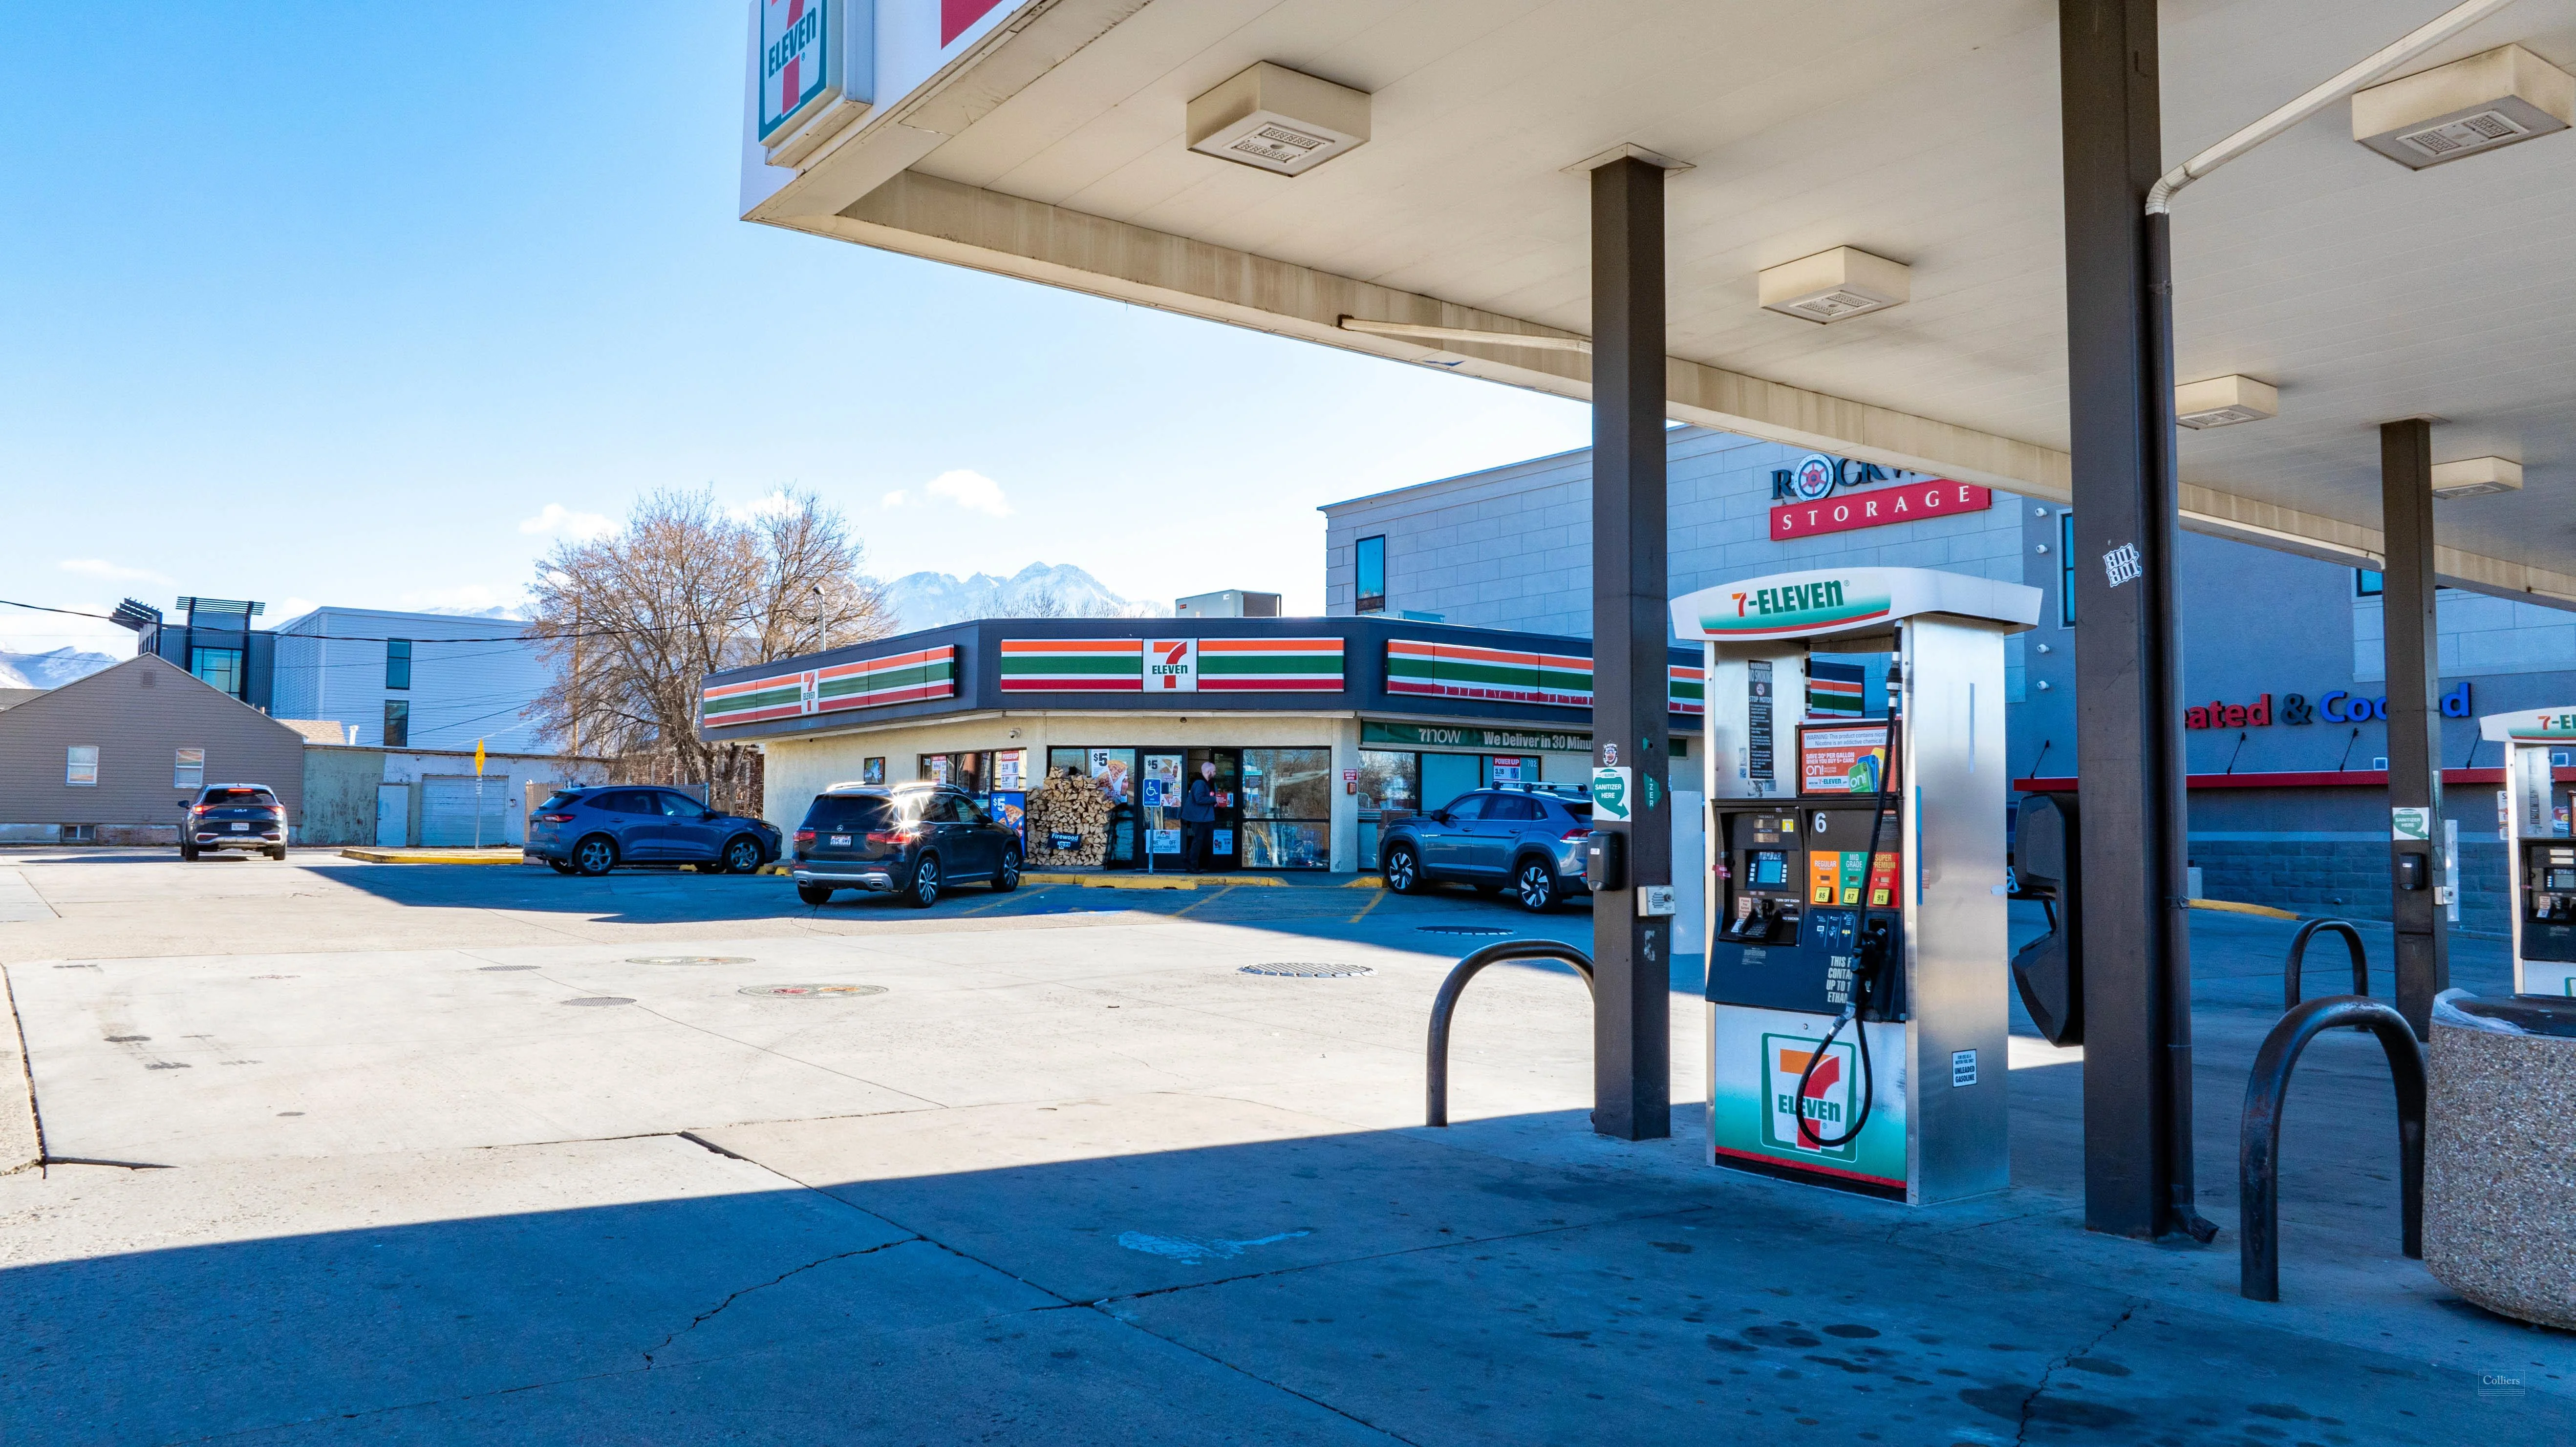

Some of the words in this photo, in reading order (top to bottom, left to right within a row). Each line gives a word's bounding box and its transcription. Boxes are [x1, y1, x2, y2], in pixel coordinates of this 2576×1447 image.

[1783, 485, 1969, 530] STORAGE
[1153, 641, 1187, 688] 7
[1749, 669, 1754, 682] NO
[1755, 670, 1772, 683] SMOKING
[2184, 693, 2271, 729] ated
[2280, 693, 2313, 725] &
[1484, 731, 1500, 745] We
[1503, 732, 1539, 747] Deliver
[1541, 734, 1550, 748] in
[1552, 735, 1565, 749] 30
[1567, 736, 1593, 750] Minu
[1094, 753, 1107, 766] $5
[1148, 760, 1158, 769] $5
[993, 797, 1005, 811] $5
[1815, 812, 1826, 832] 6
[1831, 956, 1846, 967] THIS
[1826, 979, 1836, 990] UP
[1837, 980, 1845, 991] TO
[1955, 1065, 1975, 1074] UNLEADED
[1955, 1074, 1975, 1083] GASOLINE
